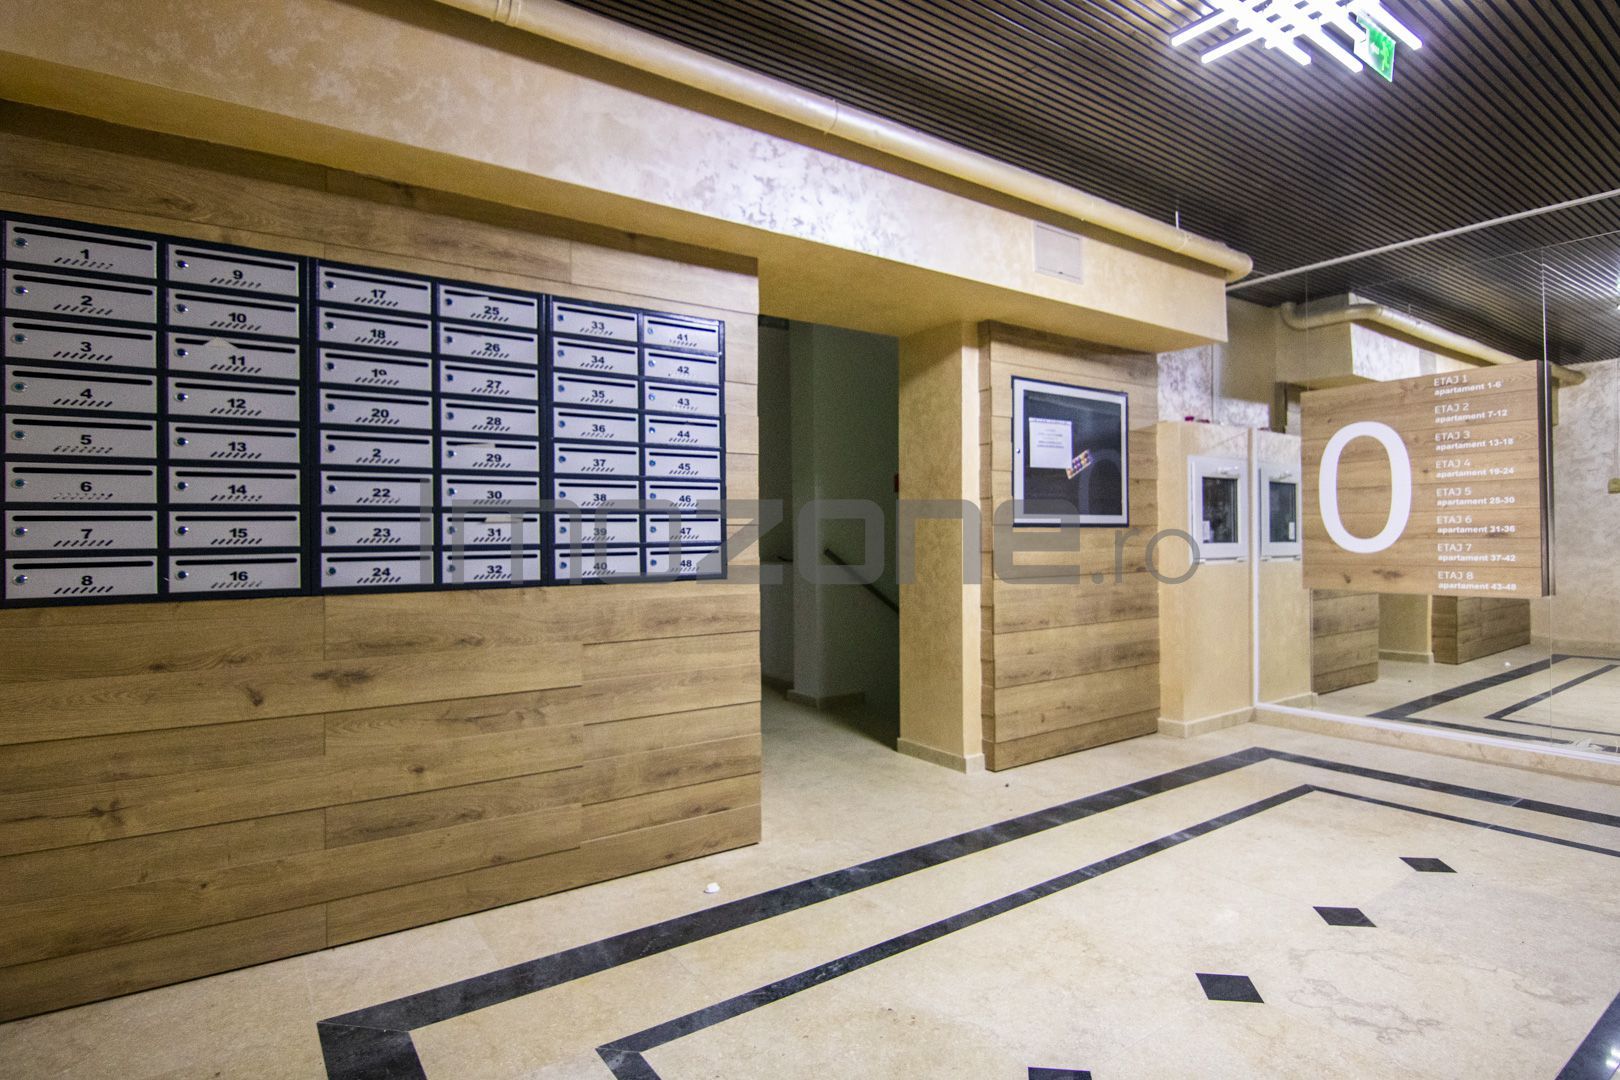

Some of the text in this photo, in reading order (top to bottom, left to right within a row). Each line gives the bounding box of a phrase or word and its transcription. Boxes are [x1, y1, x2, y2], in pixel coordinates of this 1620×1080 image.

[80, 250, 90, 259] 1
[233, 270, 243, 280] 9
[371, 290, 386, 299] 17
[81, 296, 92, 306] 2
[484, 306, 499, 315] 25
[228, 313, 247, 322] 10
[592, 322, 605, 330] 33
[370, 329, 385, 338] 18
[80, 342, 92, 352] 3
[485, 343, 500, 352] 26
[228, 356, 245, 366] 11
[592, 356, 604, 364] 34
[486, 380, 502, 389] 27
[1434, 376, 1459, 386] ETAJ
[80, 389, 92, 399] 4
[592, 390, 605, 398] 35
[1434, 384, 1484, 396] apartament
[227, 399, 246, 408] 12
[1434, 403, 1469, 414] ETAJ 2
[372, 409, 389, 418] 20
[486, 417, 501, 425] 28
[1435, 413, 1484, 424] apartament
[80, 435, 92, 445] 5
[1435, 431, 1470, 442] ETAJ 3
[228, 442, 246, 452] 13
[1436, 441, 1486, 451] apartament
[486, 454, 502, 462] 29
[593, 459, 606, 467] 37
[1436, 459, 1471, 469] ETAJ 4
[1436, 470, 1486, 479] apartament
[80, 482, 92, 492] 6
[228, 485, 246, 494] 14
[373, 489, 390, 497] 22
[487, 491, 502, 499] 30
[1436, 488, 1471, 497] ETAJ 5
[1437, 497, 1487, 507] apartament
[1437, 516, 1471, 524] ETAJ 6
[81, 529, 93, 539] 7
[230, 528, 248, 538] 15
[373, 528, 391, 537] 23
[1437, 526, 1487, 534] apartament
[1437, 544, 1471, 552] ETAJ 7
[1438, 555, 1488, 563] apartament
[373, 568, 391, 576] 24
[487, 566, 502, 574] 32
[230, 572, 248, 581] 16
[1438, 571, 1473, 580] ETAJ 8
[82, 576, 93, 585] 8
[1439, 582, 1489, 591] apartament
